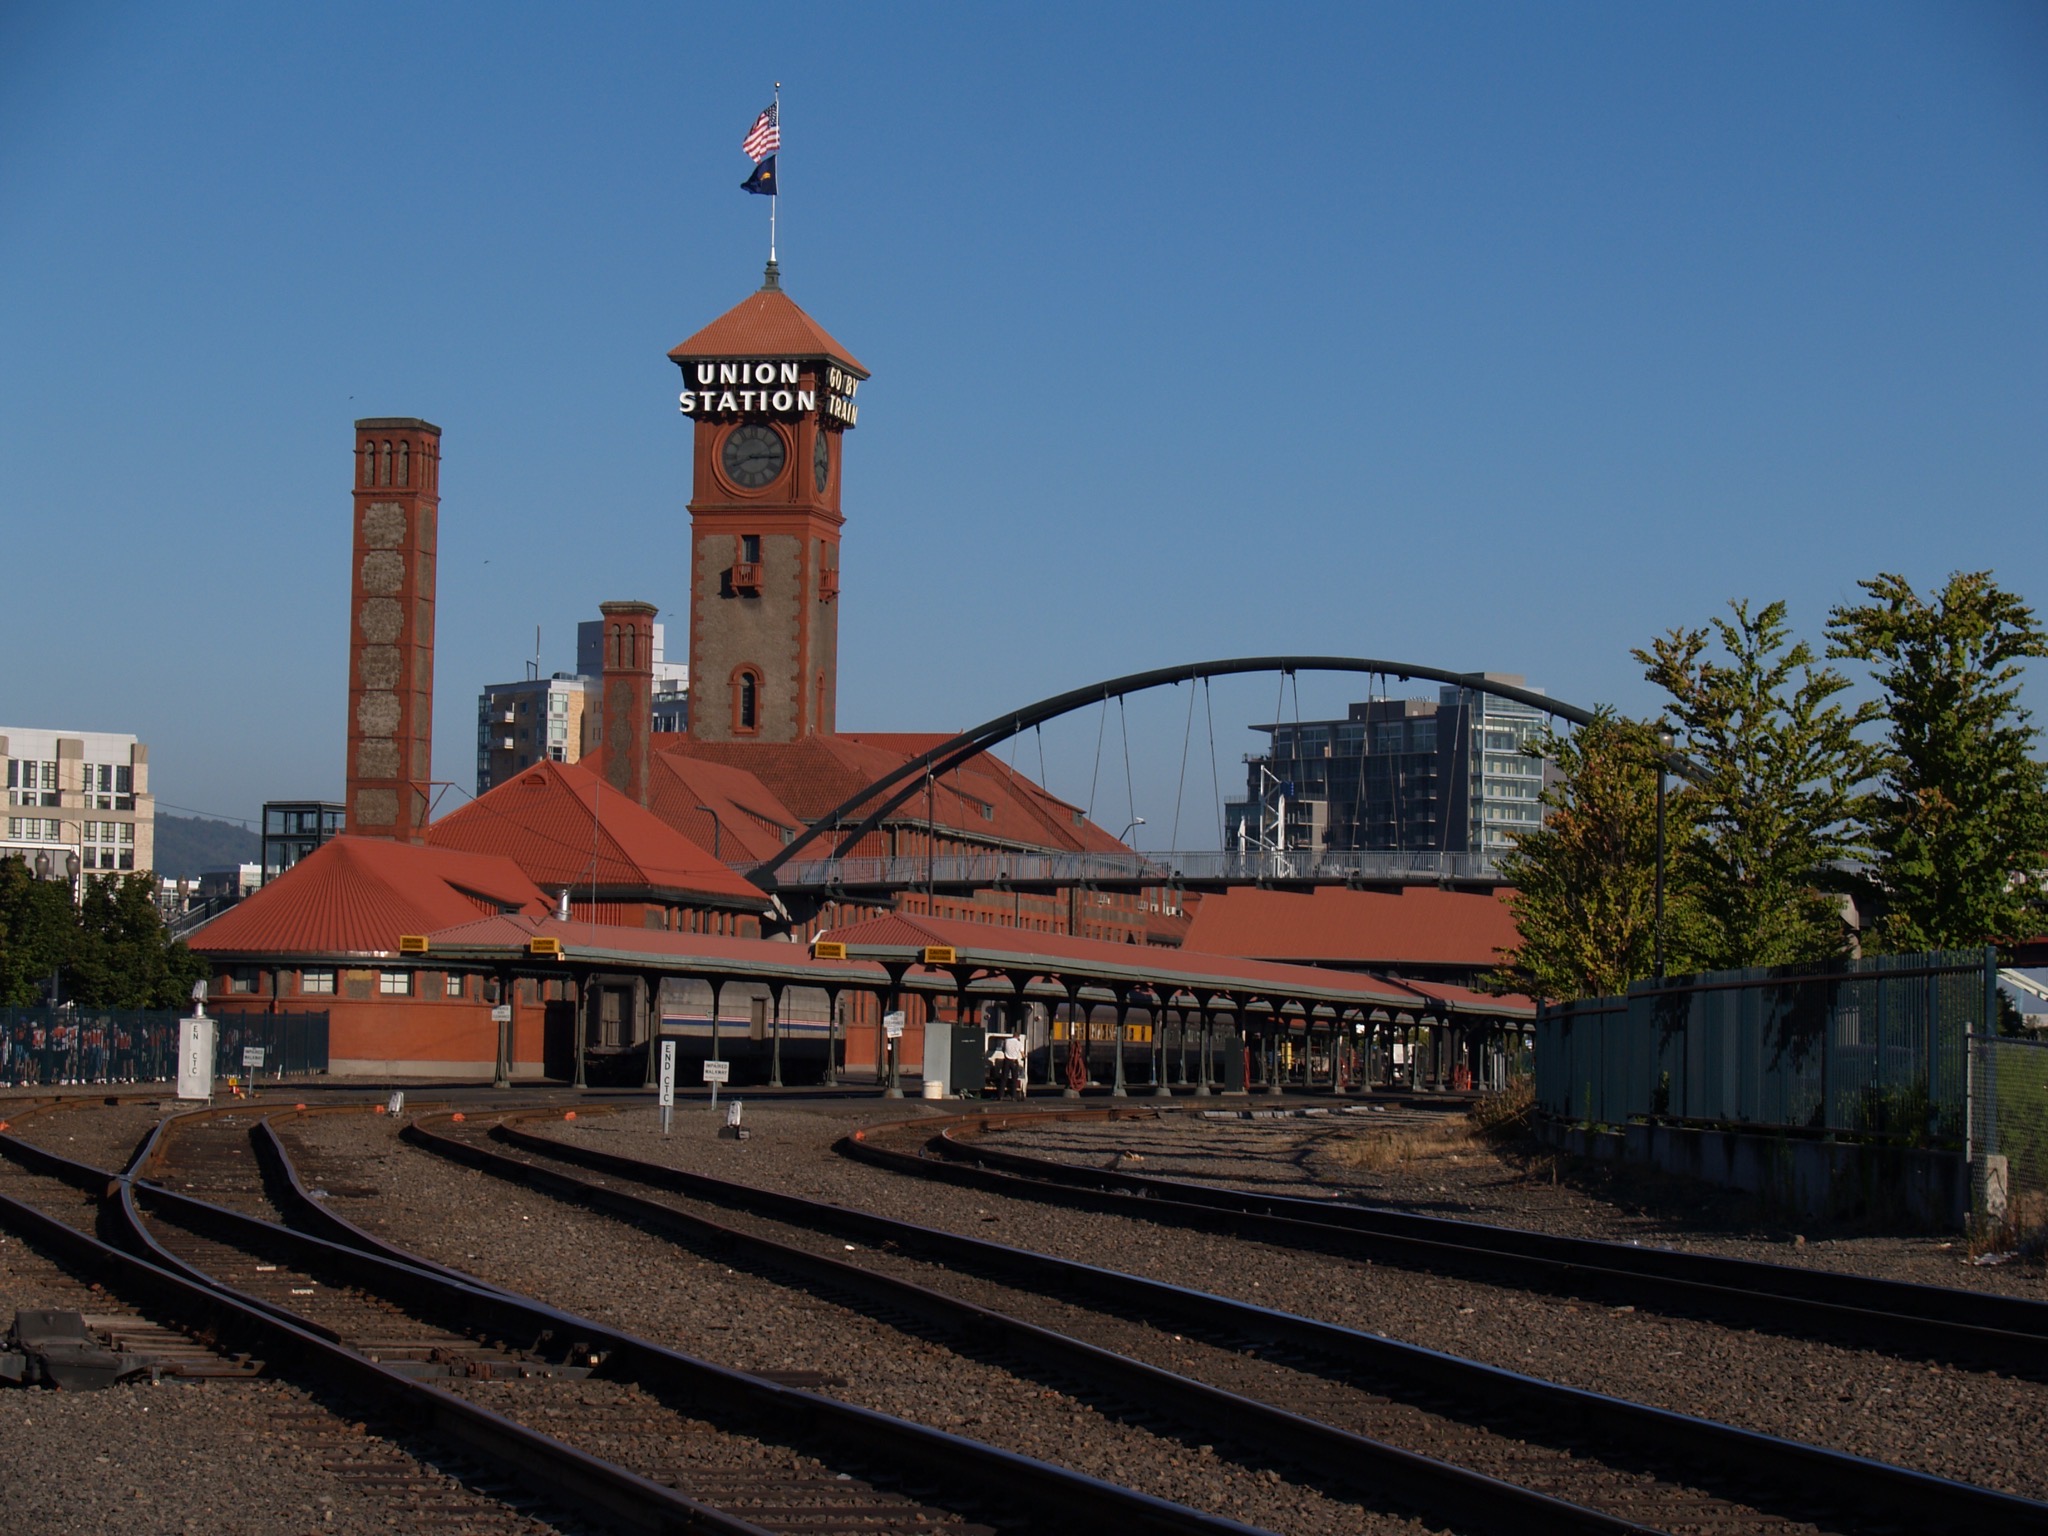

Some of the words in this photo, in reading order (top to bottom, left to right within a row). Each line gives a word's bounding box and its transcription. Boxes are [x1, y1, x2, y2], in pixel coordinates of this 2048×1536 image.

[697, 363, 798, 384] UNION
[829, 367, 842, 391] GO
[845, 375, 859, 398] BY
[679, 390, 816, 412] STATION
[829, 394, 858, 425] TRAIN
